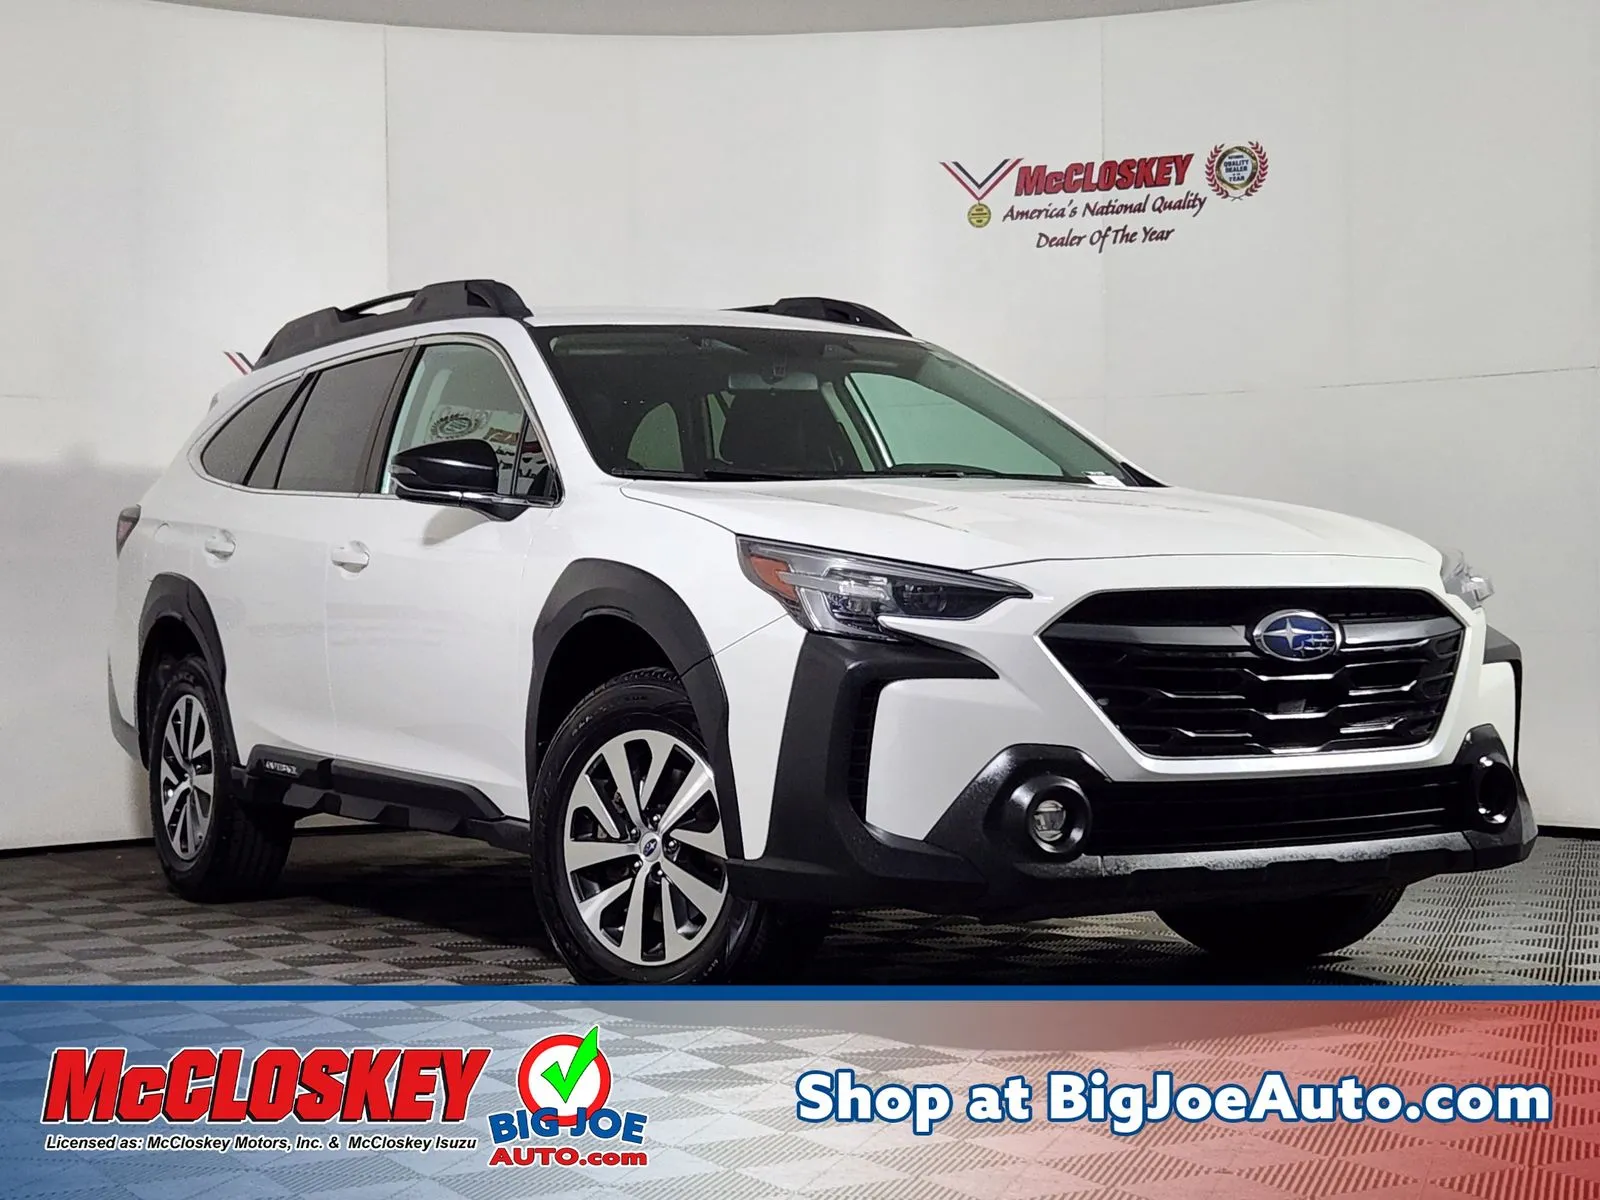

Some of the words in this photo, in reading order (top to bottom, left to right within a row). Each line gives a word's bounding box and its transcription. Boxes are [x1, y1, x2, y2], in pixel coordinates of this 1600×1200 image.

[1014, 153, 1194, 196] McCLOSKEY
[1002, 199, 1078, 222] America's
[1082, 194, 1150, 217] National
[1152, 190, 1207, 218] Quality
[1036, 228, 1087, 248] Dealer
[1089, 226, 1112, 254] Of
[1112, 224, 1138, 244] The
[1141, 226, 1175, 243] Year
